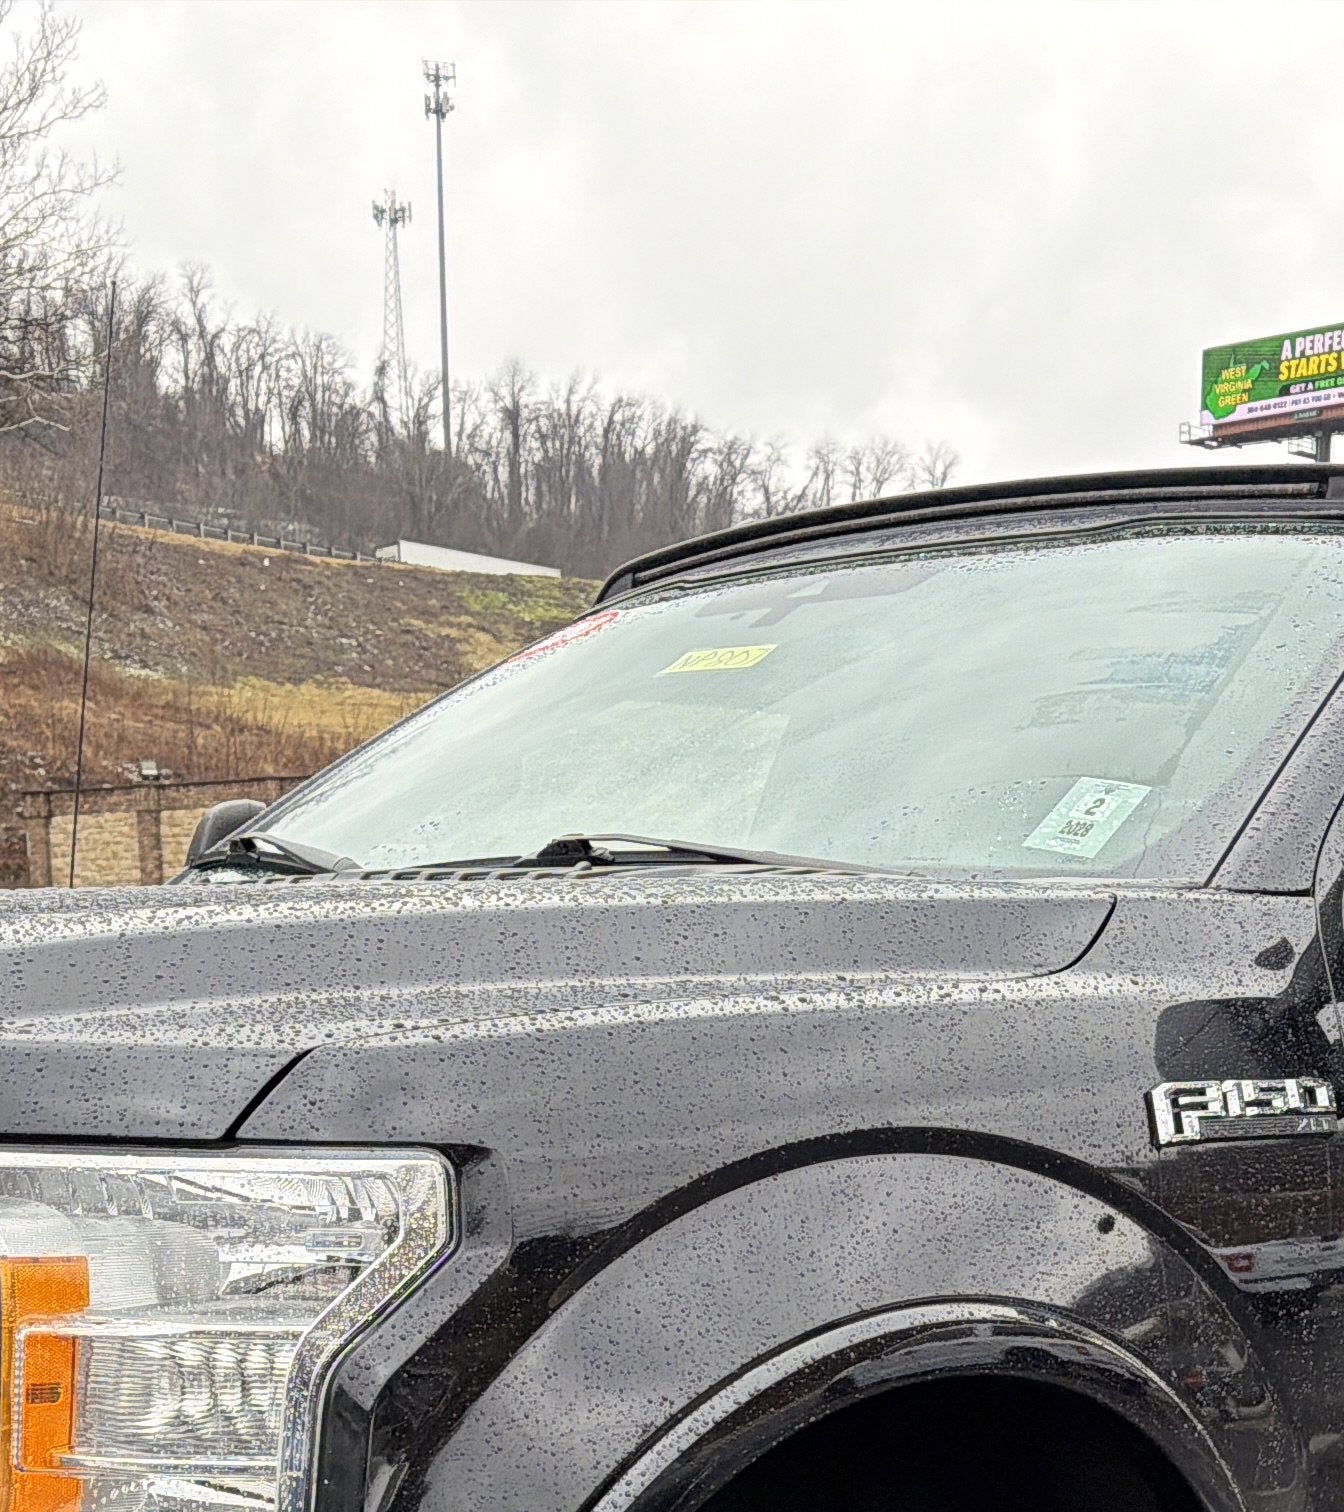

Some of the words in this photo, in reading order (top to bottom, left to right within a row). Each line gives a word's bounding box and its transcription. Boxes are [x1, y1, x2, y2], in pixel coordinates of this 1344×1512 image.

[1281, 339, 1292, 360] A
[1221, 364, 1247, 380] WEST
[1279, 352, 1338, 381] STARTS
[1216, 379, 1253, 394] VIRGINIA
[1289, 382, 1306, 394] GET
[1306, 382, 1314, 392] A
[1315, 378, 1335, 389] FREE
[1218, 392, 1249, 408] GREEN
[1083, 797, 1106, 816] 2
[1058, 820, 1095, 838] 2028
